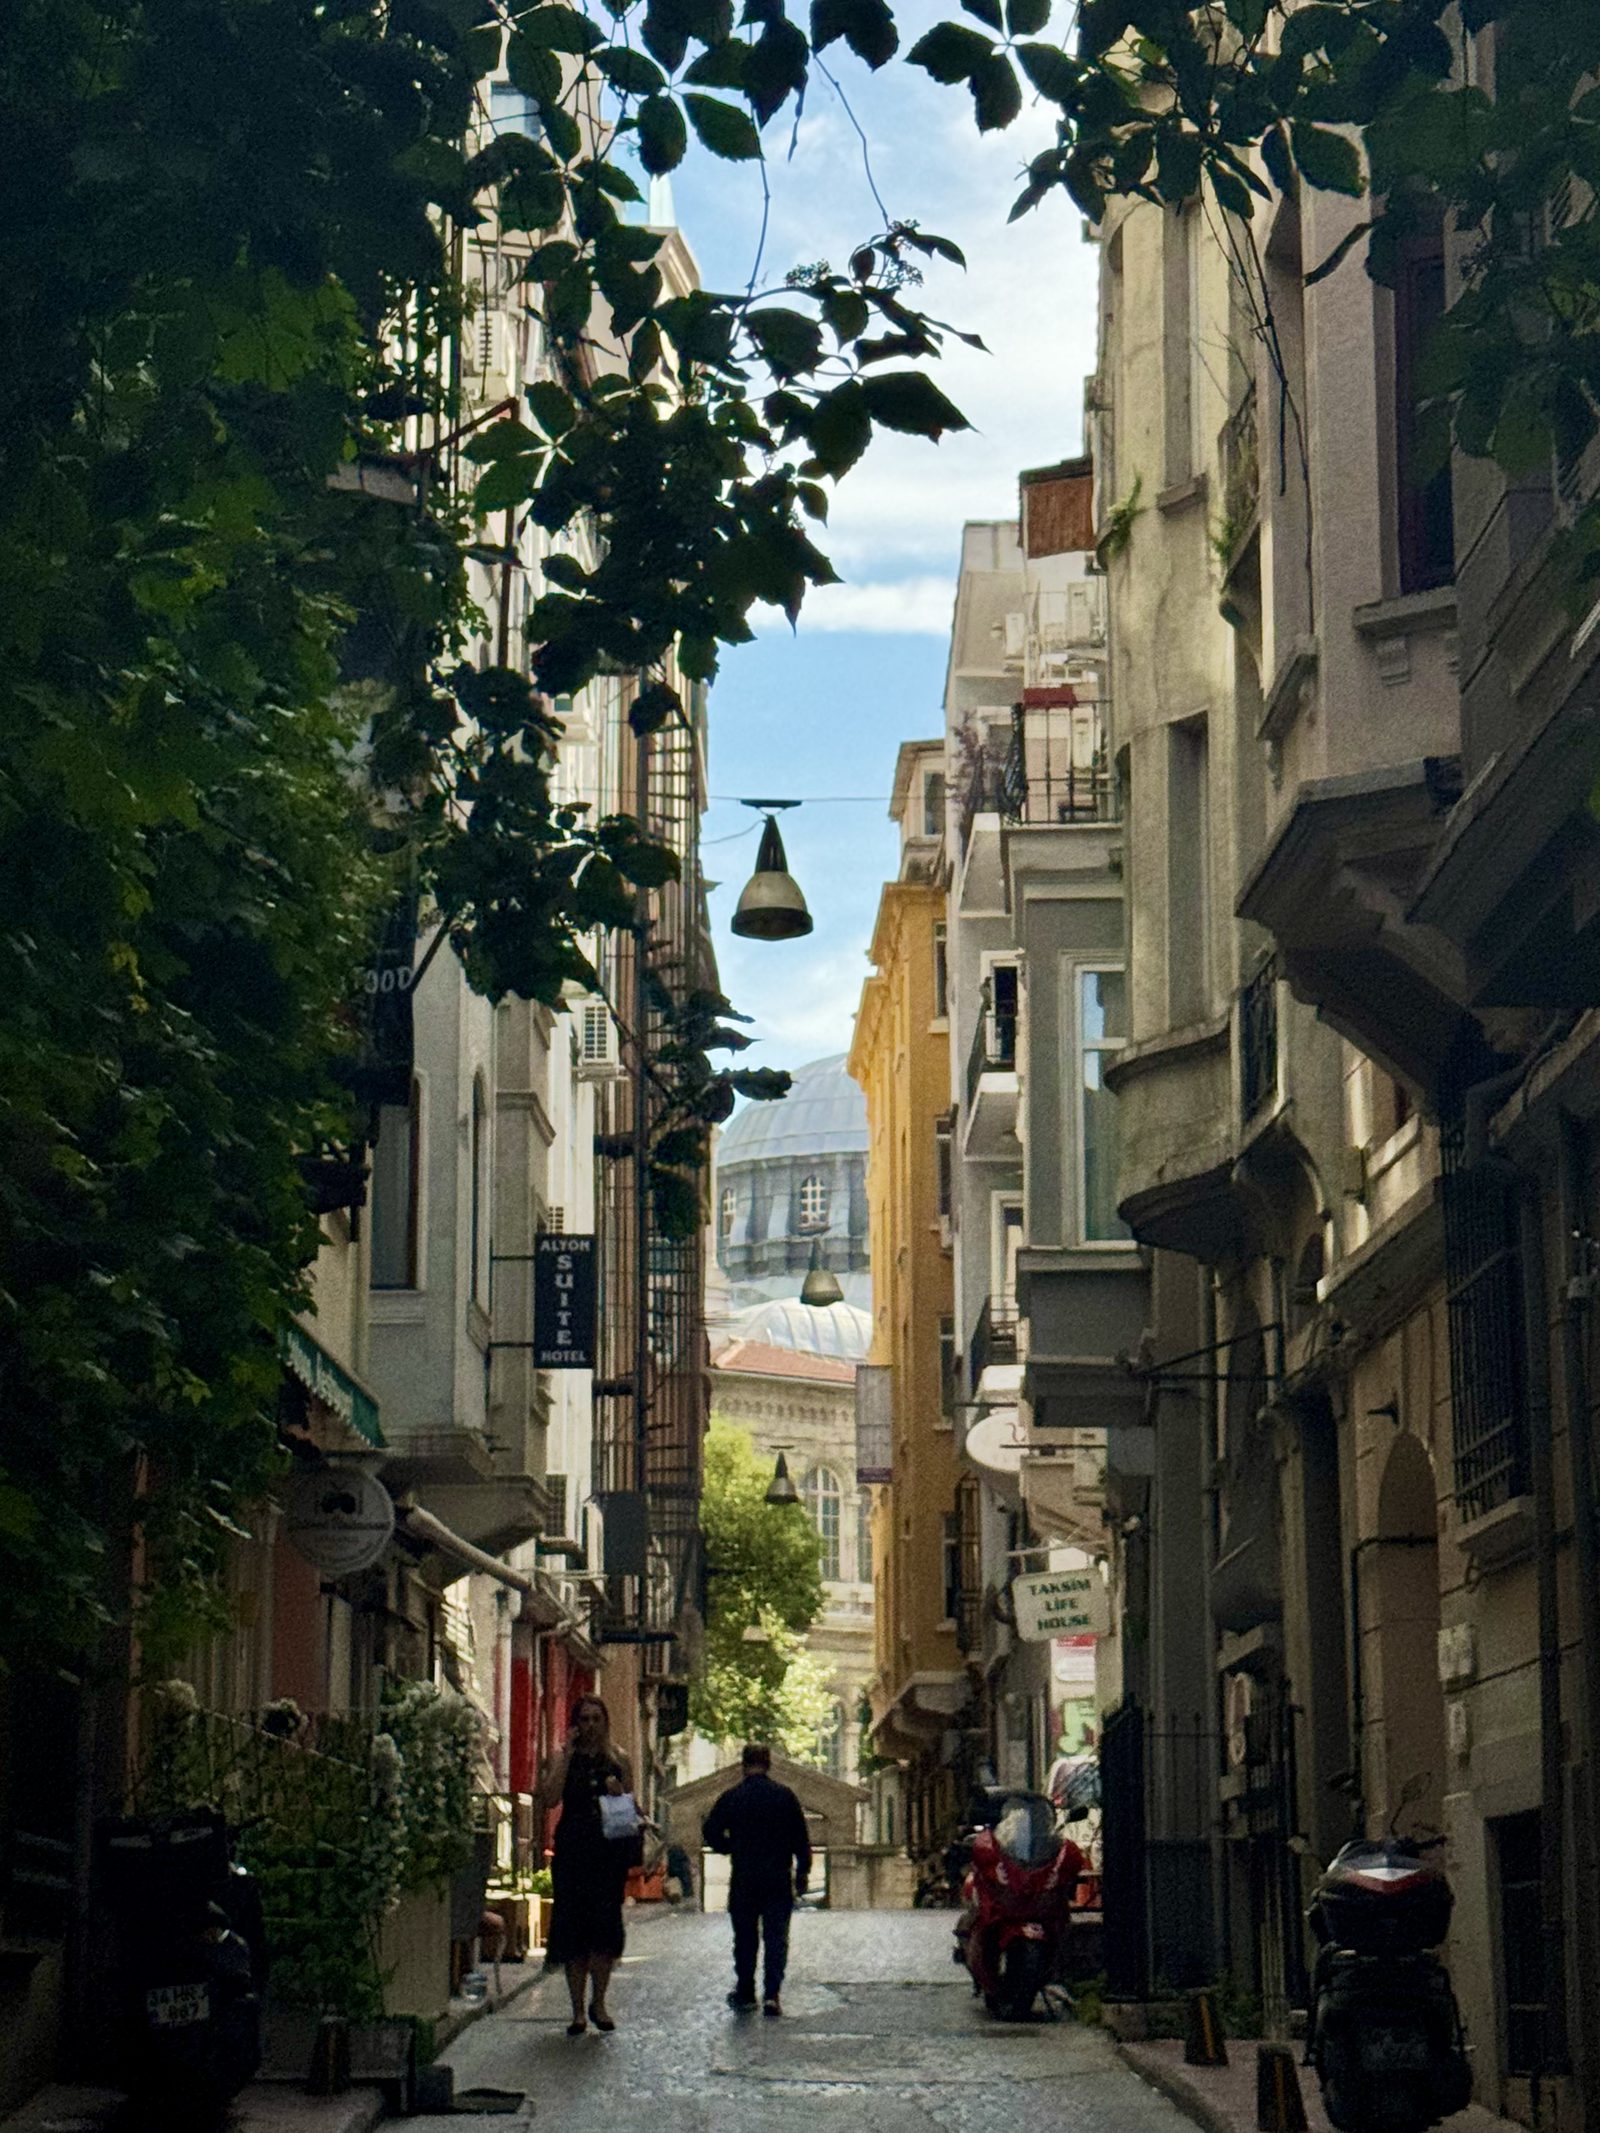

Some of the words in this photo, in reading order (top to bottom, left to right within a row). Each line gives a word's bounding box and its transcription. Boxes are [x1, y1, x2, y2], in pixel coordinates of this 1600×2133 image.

[554, 1254, 574, 1346] SUITE
[540, 1350, 586, 1362] HOTEL
[1037, 1614, 1090, 1631] HOUSE
